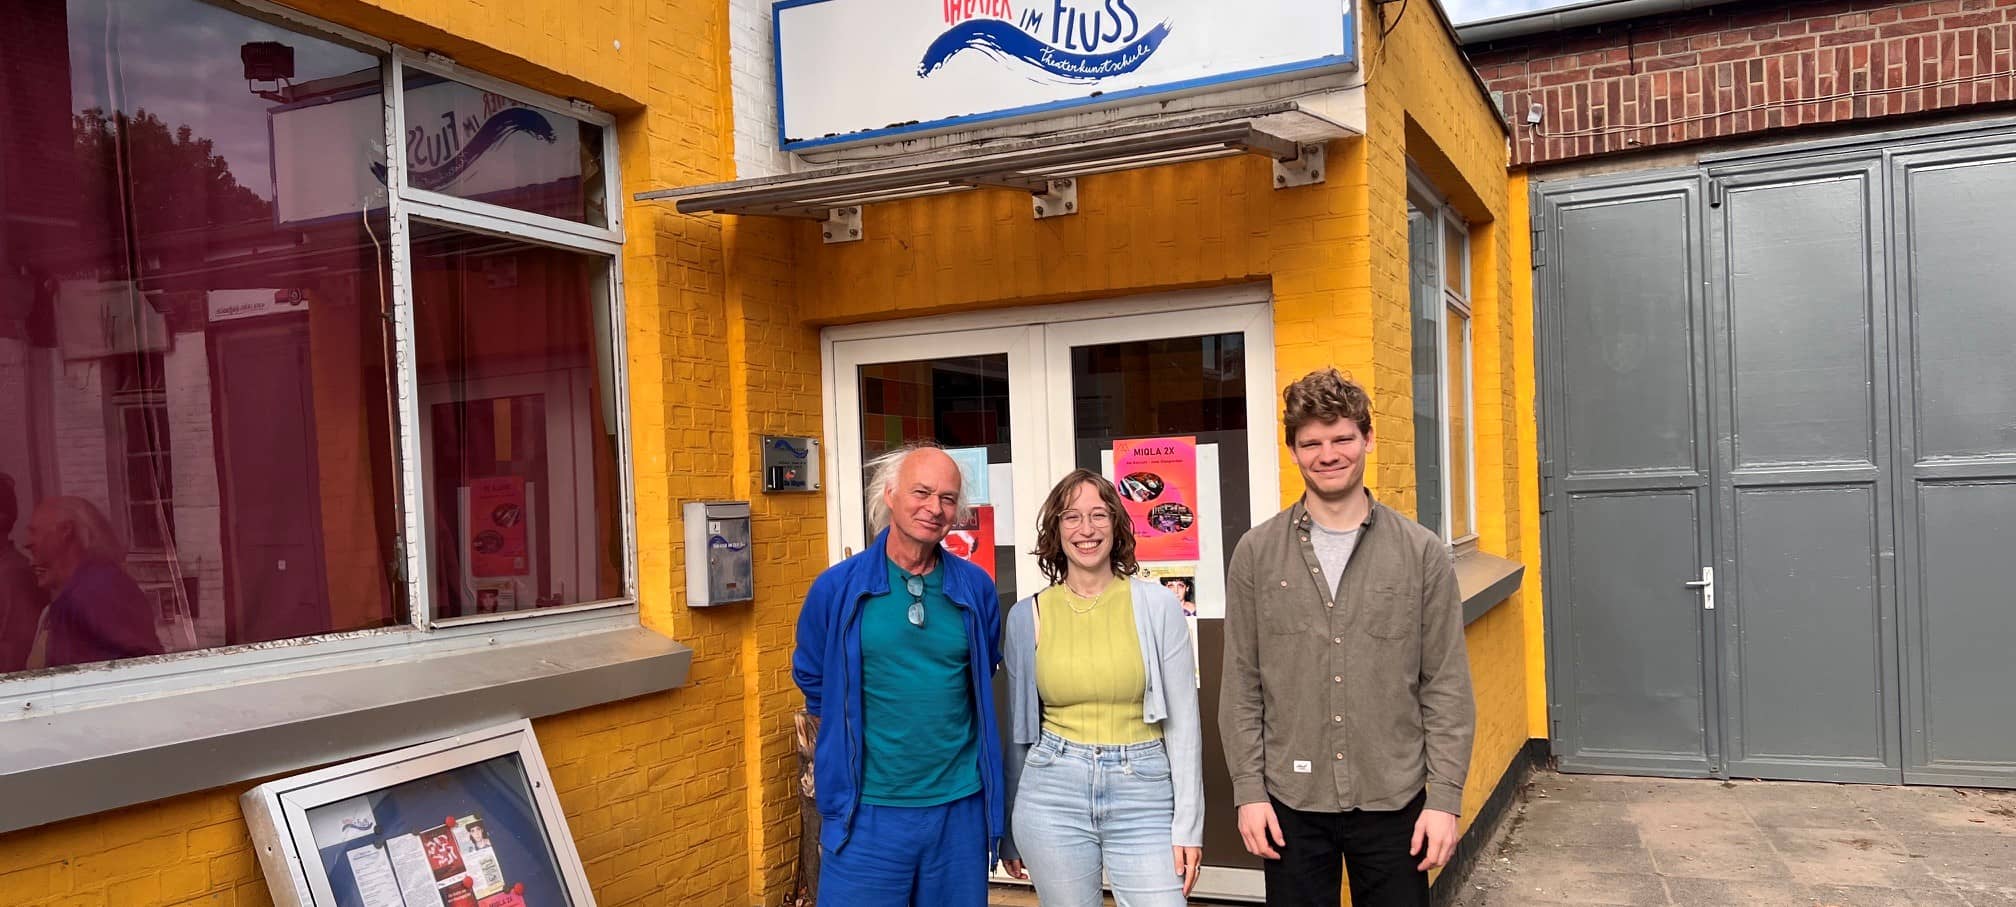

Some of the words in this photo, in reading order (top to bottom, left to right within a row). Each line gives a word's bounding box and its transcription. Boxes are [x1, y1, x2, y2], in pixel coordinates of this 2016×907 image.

[1019, 7, 1043, 34] IM
[1052, 0, 1139, 53] FLUSS
[1133, 447, 1162, 456] MIQLA
[1164, 446, 1175, 456] 2X
